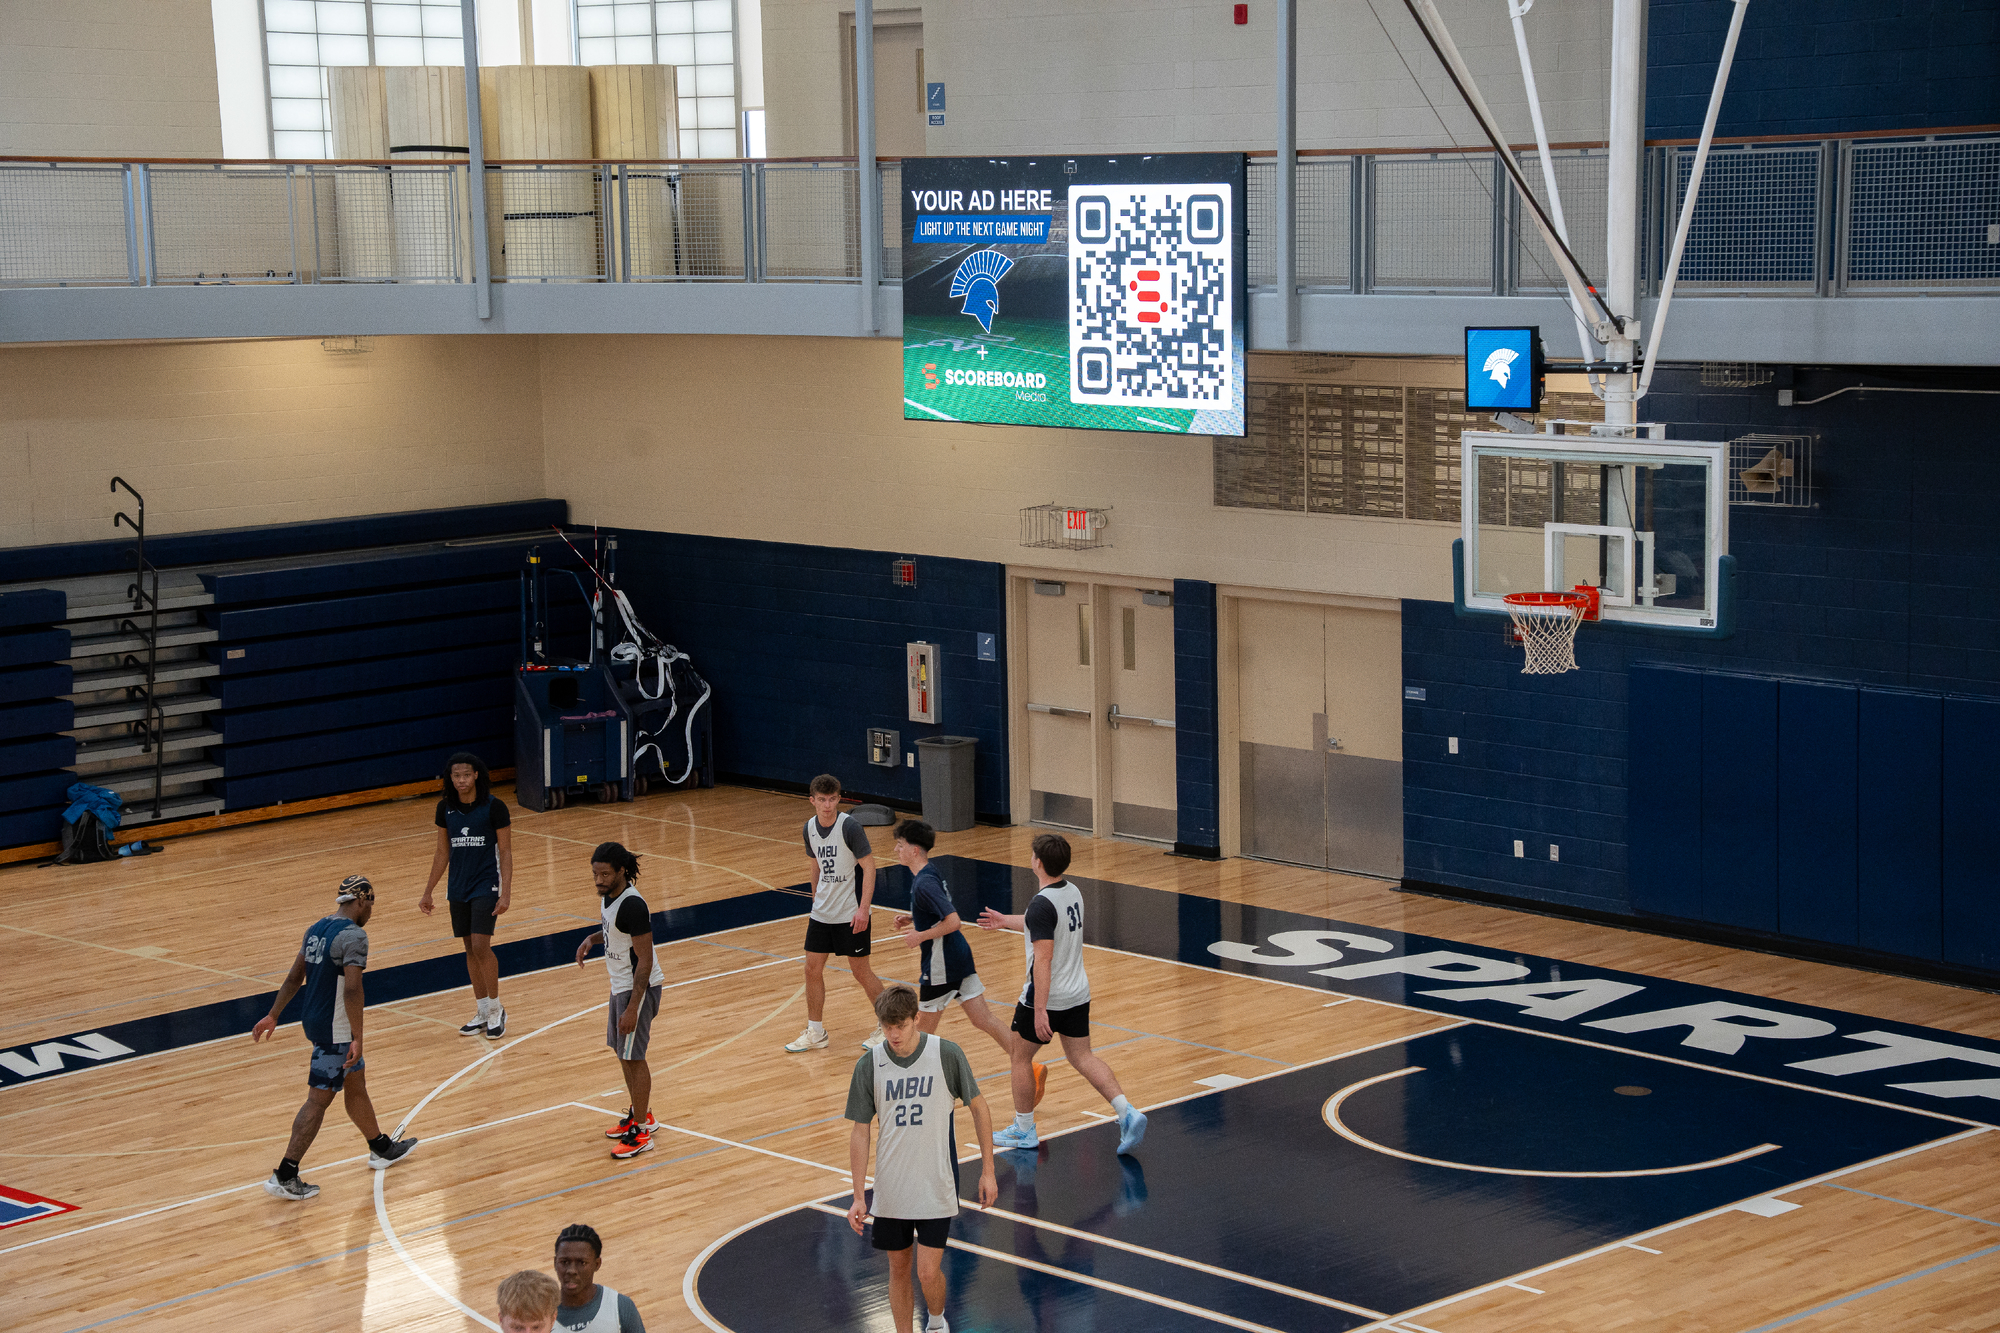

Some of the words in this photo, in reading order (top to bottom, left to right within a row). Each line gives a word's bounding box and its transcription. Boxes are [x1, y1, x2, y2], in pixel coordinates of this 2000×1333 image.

[911, 190, 964, 211] YOUR
[968, 190, 995, 211] AD
[1001, 189, 1053, 211] HERE
[920, 221, 942, 236] LIGHT
[943, 221, 954, 236] UP
[956, 221, 971, 236] THE
[973, 221, 994, 236] NEXT
[995, 221, 1019, 236] GAME
[1020, 221, 1045, 236] NIGHT
[945, 369, 1046, 389] SCOREBOARD
[1015, 390, 1047, 402] Media
[1067, 510, 1087, 530] EXIT
[817, 845, 838, 858] MBU
[821, 858, 835, 875] 22
[1066, 901, 1083, 933] 31
[304, 934, 327, 965] 20
[885, 1075, 934, 1102] MBU
[895, 1103, 923, 1127] 22
